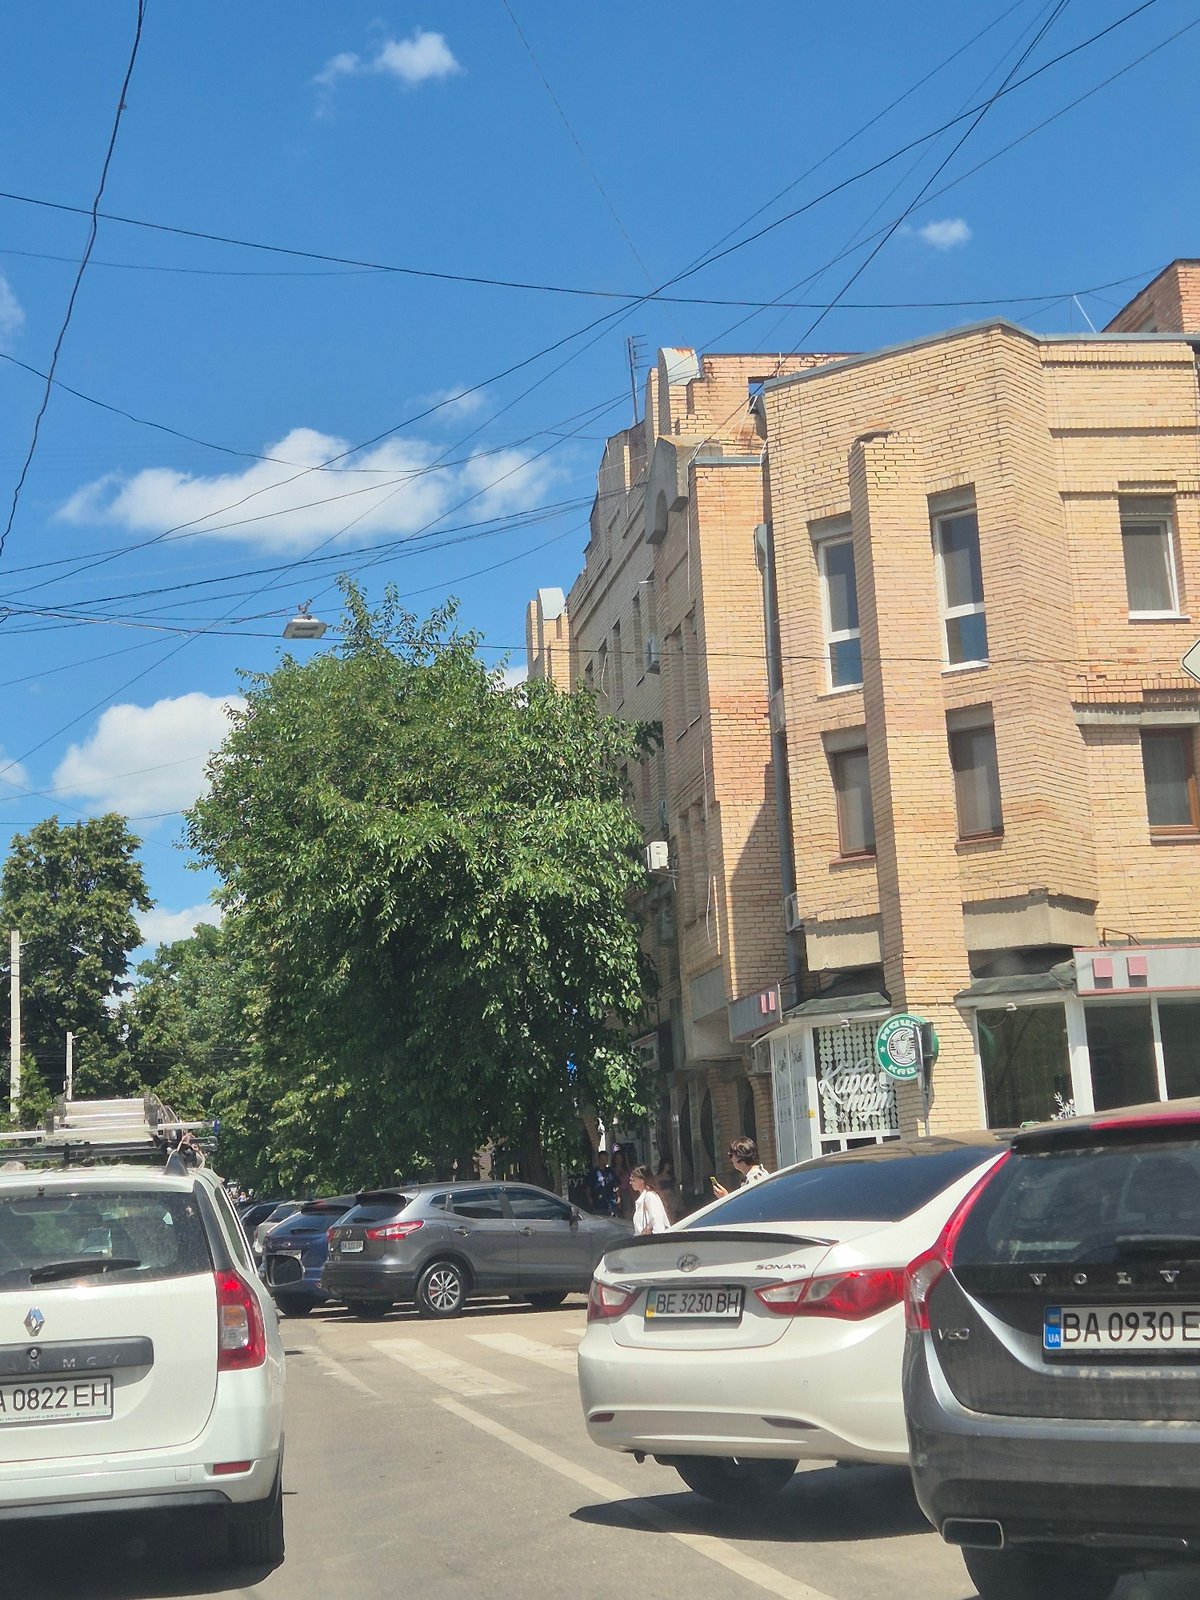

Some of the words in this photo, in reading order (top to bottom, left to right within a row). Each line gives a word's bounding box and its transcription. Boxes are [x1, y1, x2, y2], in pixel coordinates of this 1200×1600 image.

[880, 1018, 915, 1041] НАШ
[887, 1063, 917, 1076] КАВ
[754, 1263, 807, 1271] SONATA
[1029, 1270, 1180, 1286] VOLV
[656, 1293, 677, 1313] BE
[679, 1292, 712, 1313] 3230
[716, 1292, 739, 1314] BH
[937, 1327, 970, 1341] V60
[1063, 1312, 1101, 1343] BA
[1108, 1311, 1174, 1342] 0930
[1182, 1311, 1200, 1342] E
[1048, 1335, 1060, 1344] UA
[13, 1386, 68, 1411] 0822
[74, 1383, 107, 1407] EH
